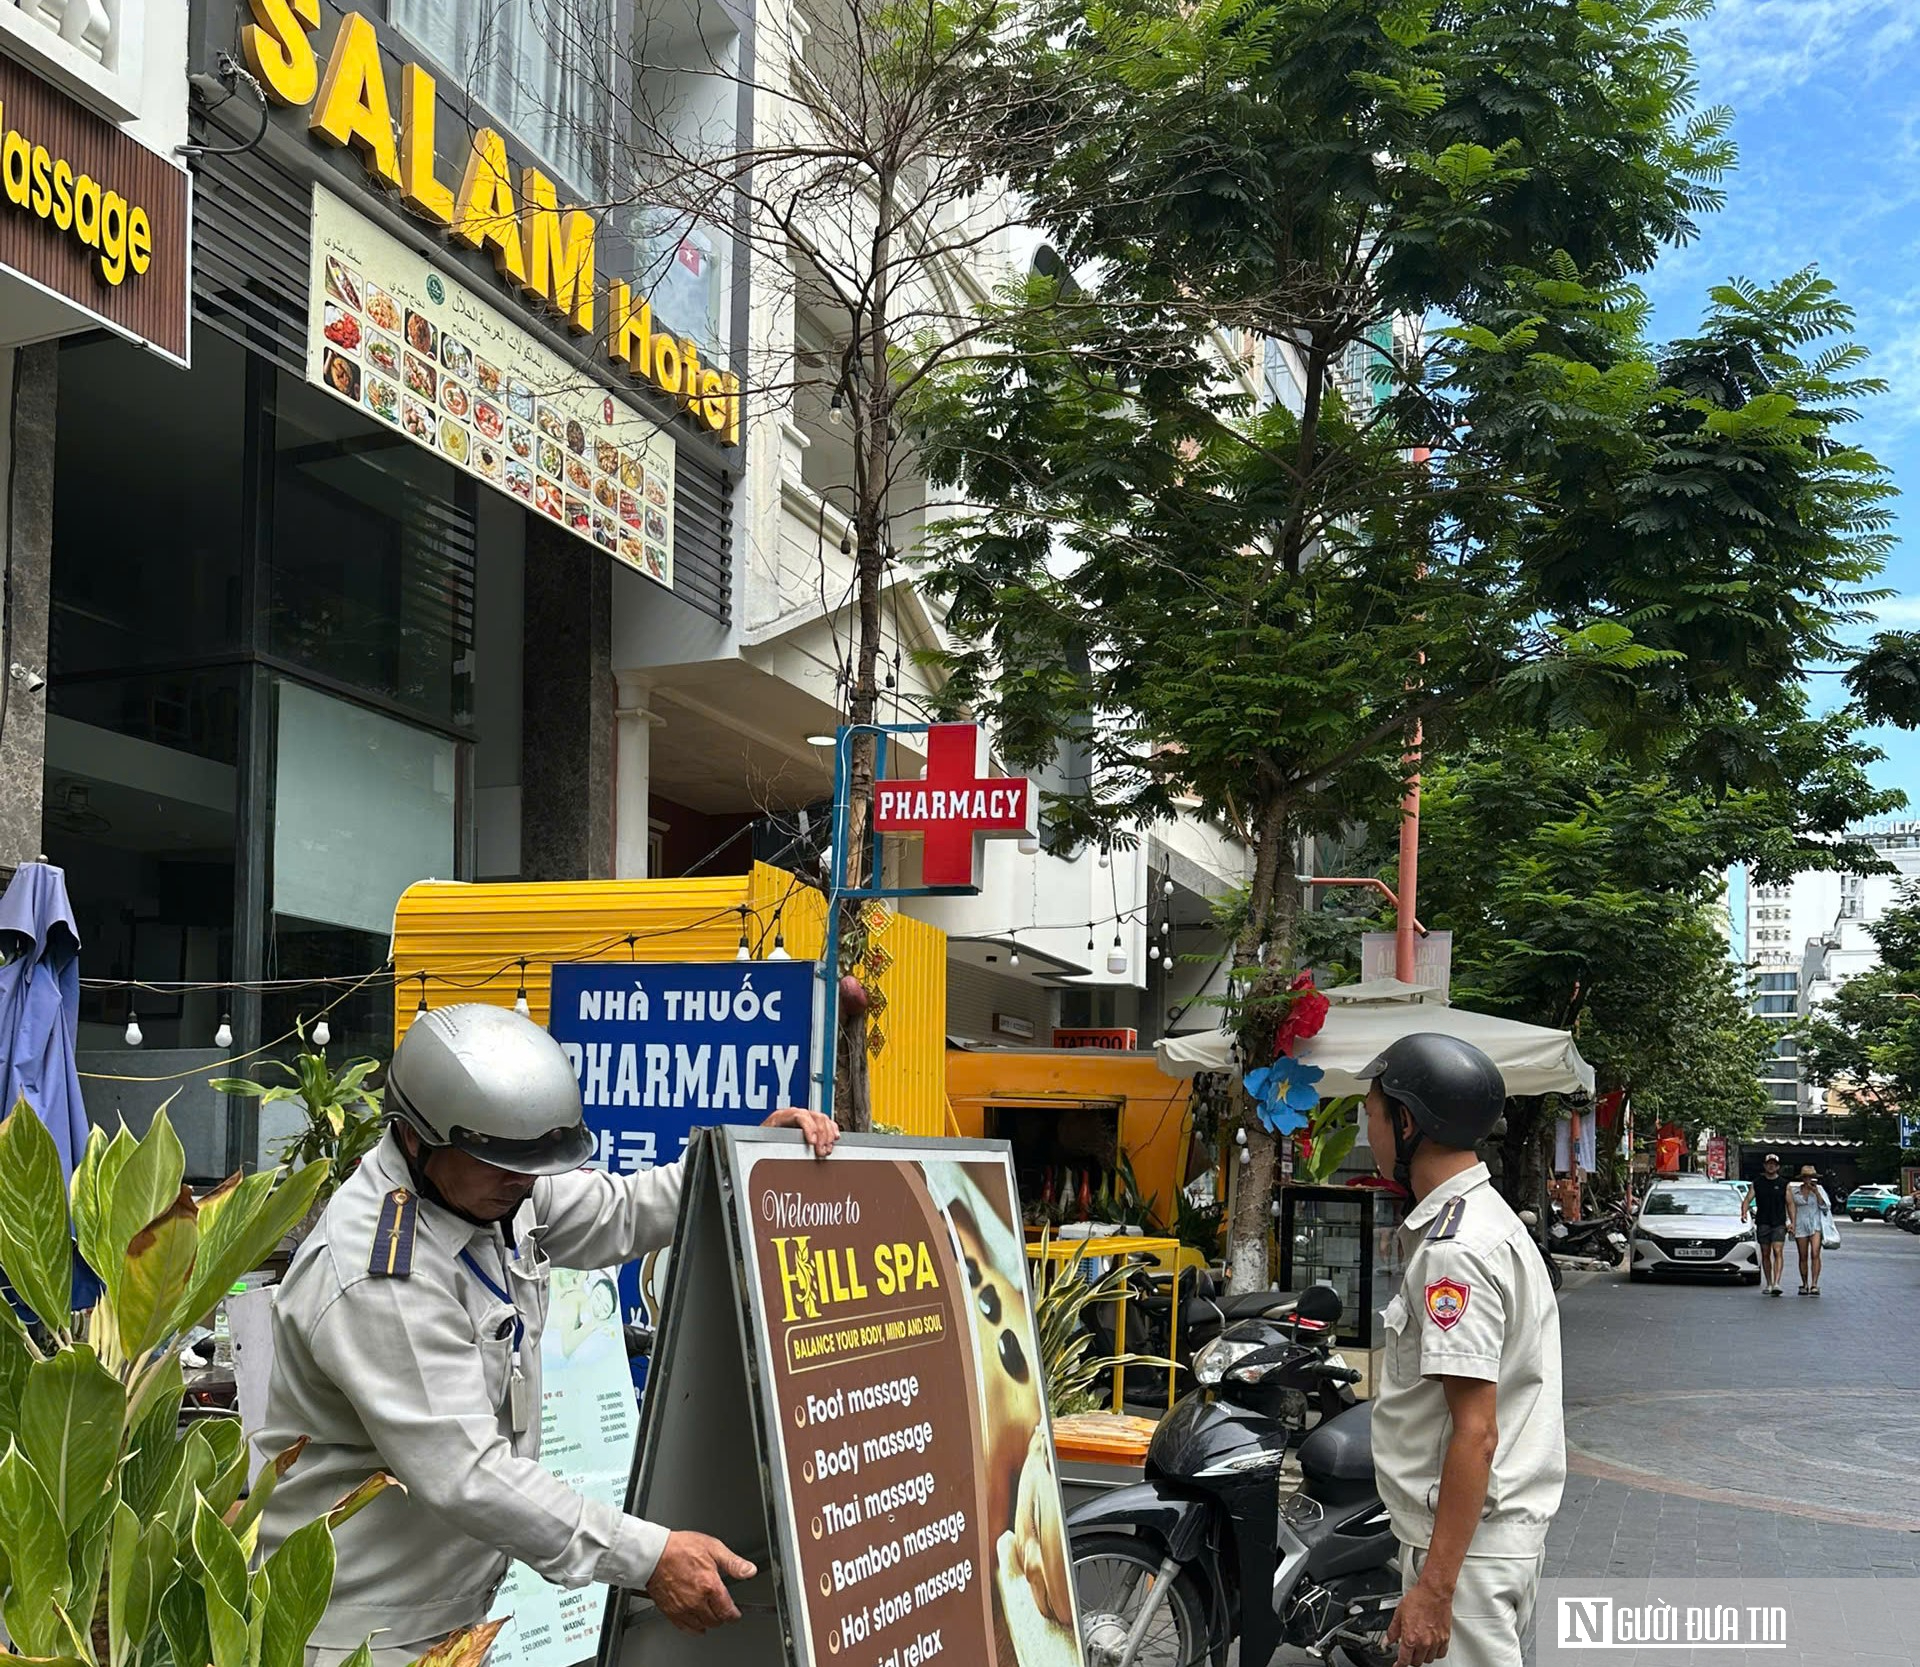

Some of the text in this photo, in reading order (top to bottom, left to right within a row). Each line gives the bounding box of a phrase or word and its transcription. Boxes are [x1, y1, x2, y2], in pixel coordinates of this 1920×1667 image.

[0, 103, 152, 286] assage
[242, 0, 741, 448] SALAM Hotel
[879, 789, 1021, 820] PHARMACY
[579, 973, 782, 1021] NHÀ THUỐC
[1058, 1035, 1123, 1049] TATTOO
[762, 1189, 860, 1229] Welcome to
[770, 1235, 940, 1322] HILL SPA
[793, 1314, 943, 1360] BALANCE YOUR BODY, MIND AND SOUL
[806, 1375, 919, 1426] Foot massage
[815, 1421, 933, 1480] Body massage
[822, 1472, 935, 1535] Thai massage
[832, 1510, 965, 1592] Bamboo massage
[559, 1593, 583, 1608] HAIRCUT
[841, 1559, 972, 1649] Hot stone massage
[903, 1629, 944, 1667] relax
